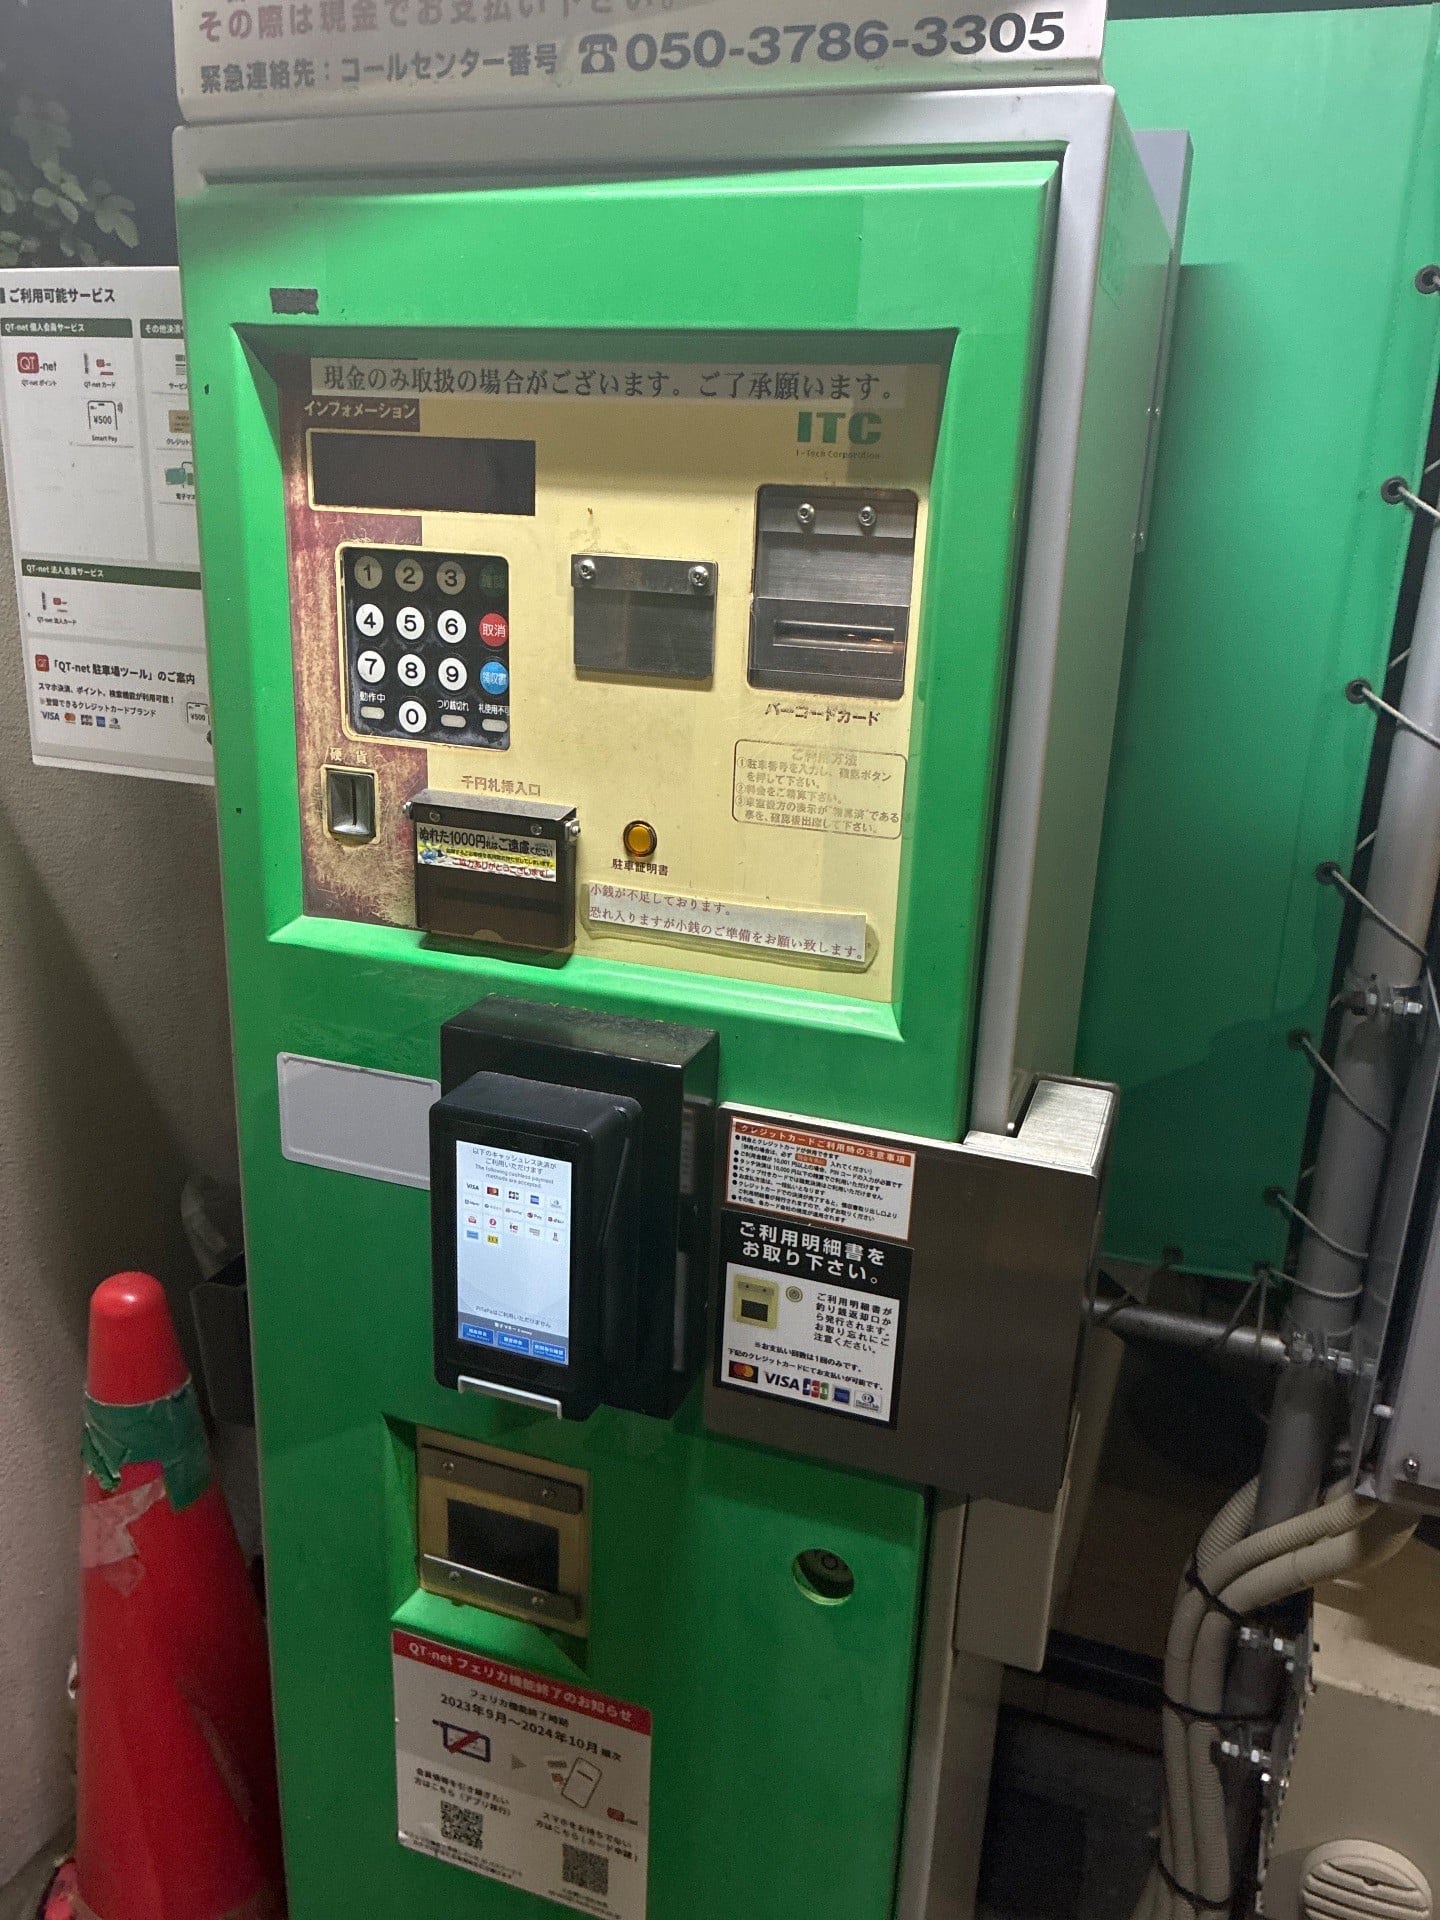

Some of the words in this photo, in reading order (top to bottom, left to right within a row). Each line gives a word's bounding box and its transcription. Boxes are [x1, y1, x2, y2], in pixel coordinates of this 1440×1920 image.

[625, 11, 1065, 72] 050-3786-3305
[9, 287, 116, 304] ご利用可能サービス
[4, 322, 29, 333] QT-net
[144, 322, 185, 335] その他決済
[304, 400, 417, 419] インフォメーション
[93, 415, 112, 425] ¥500
[797, 411, 883, 445] ITC
[26, 564, 49, 574] QT-net
[363, 564, 372, 582] 1
[402, 566, 416, 585] 2
[444, 569, 458, 587] 3
[363, 611, 377, 629] 4
[403, 614, 417, 632] 5
[445, 617, 459, 636] 6
[482, 623, 506, 638] 取消
[364, 658, 378, 675] 7
[405, 662, 418, 679] 8
[446, 665, 459, 683] 9
[359, 691, 386, 702] 動作中
[436, 699, 469, 712] つり銭切れ
[41, 711, 60, 721] VISA
[405, 708, 419, 725] 0
[764, 703, 880, 726] バーコードカード
[461, 775, 541, 797] 千円札挿入口
[612, 858, 669, 877] 駐車証明書
[590, 883, 731, 916] 小銭が不足しております。
[589, 906, 863, 961] 恐れ入りますが小銭のご準備をお願い致します。
[741, 1124, 906, 1164] クレジットカードご利用時の注意事項
[739, 1220, 886, 1267] ご利用明細書を
[741, 1240, 878, 1285] お取り下さい。
[816, 1292, 893, 1316] ご利用明細書が
[815, 1302, 892, 1326] 釣り銭返却口か
[815, 1313, 891, 1337] ら発行されます。
[813, 1333, 877, 1354] 注意ください。
[814, 1324, 890, 1347] お取り忘れにご
[764, 1370, 800, 1391] VISA
[408, 1642, 453, 1665] QT-net
